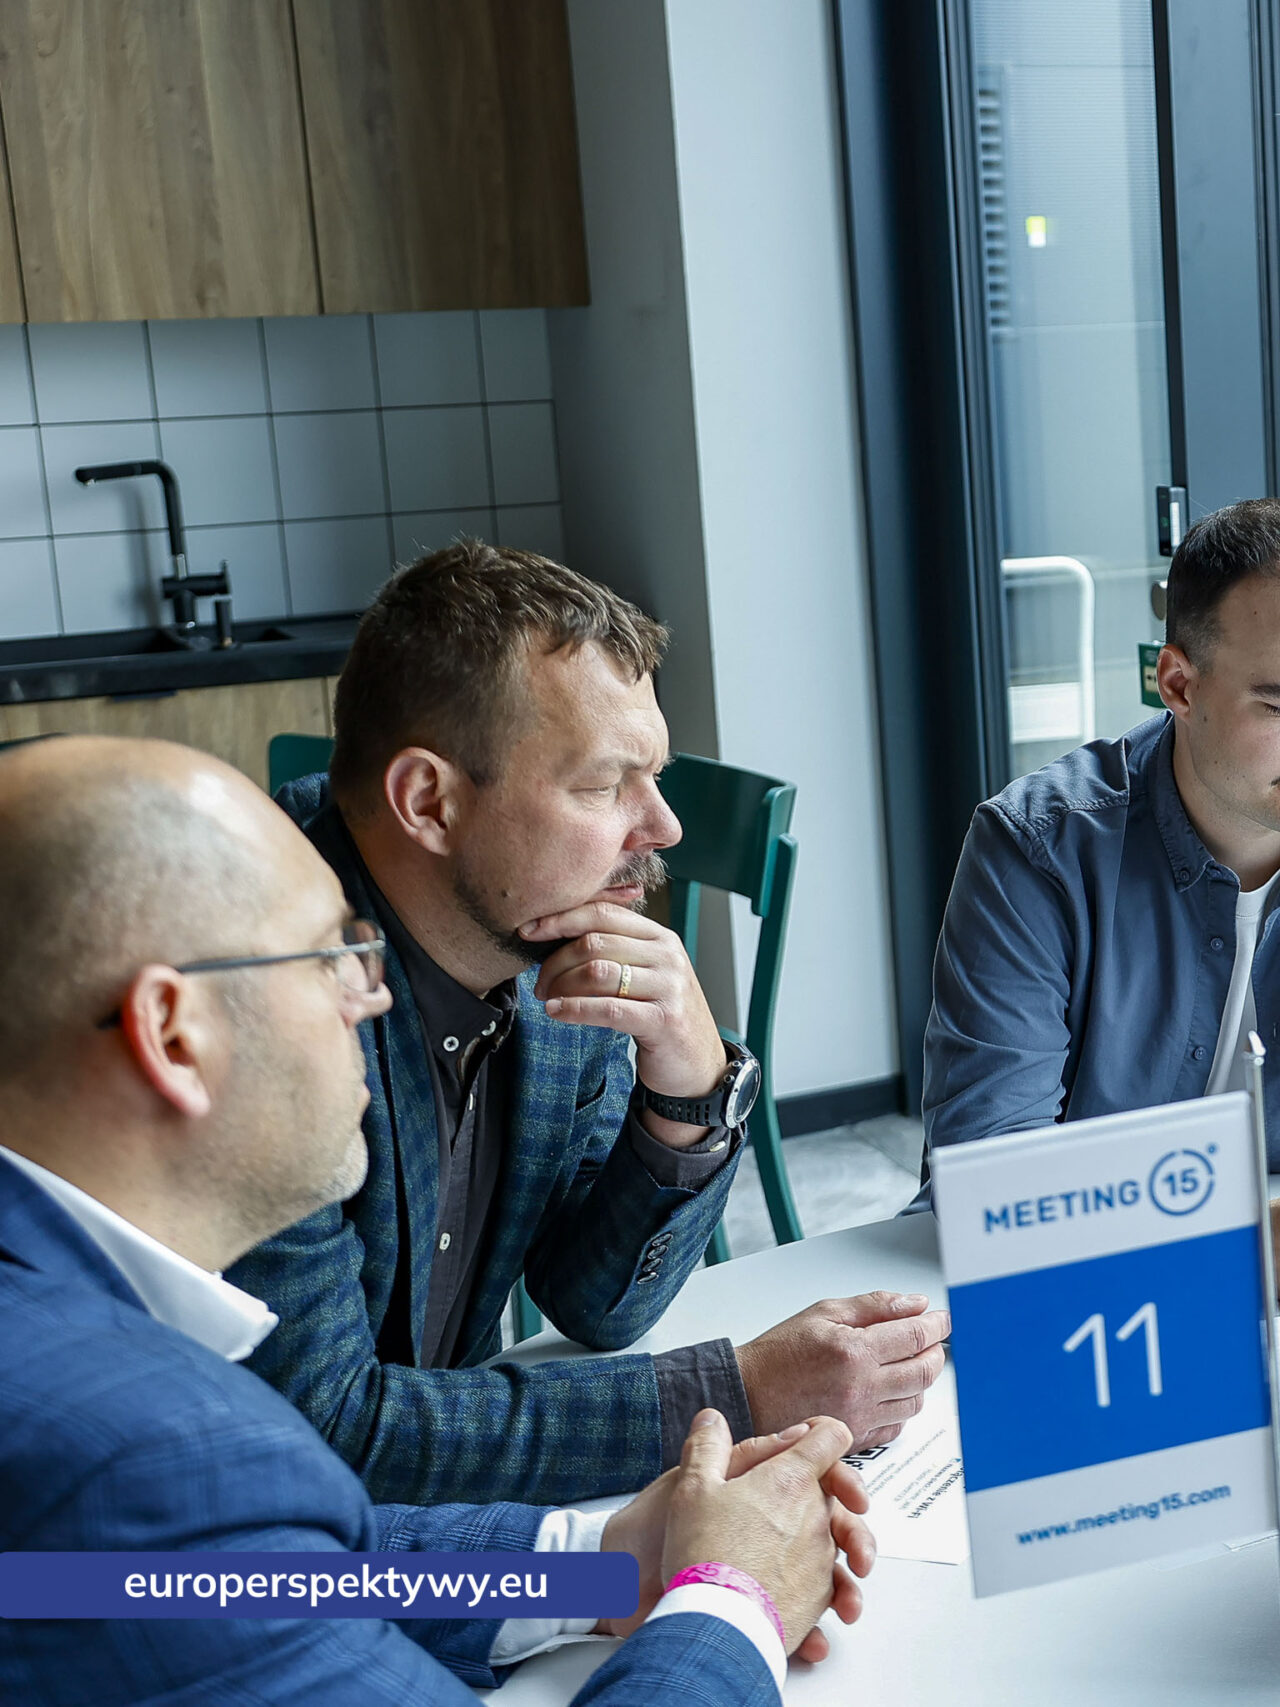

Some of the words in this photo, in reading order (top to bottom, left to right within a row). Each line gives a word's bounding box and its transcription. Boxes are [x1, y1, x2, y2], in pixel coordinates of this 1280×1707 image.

[984, 1180, 1142, 1234] MEETING
[1162, 1168, 1199, 1197] 15
[1062, 1302, 1163, 1409] 11
[1016, 1485, 1232, 1544] www.meeting15.com
